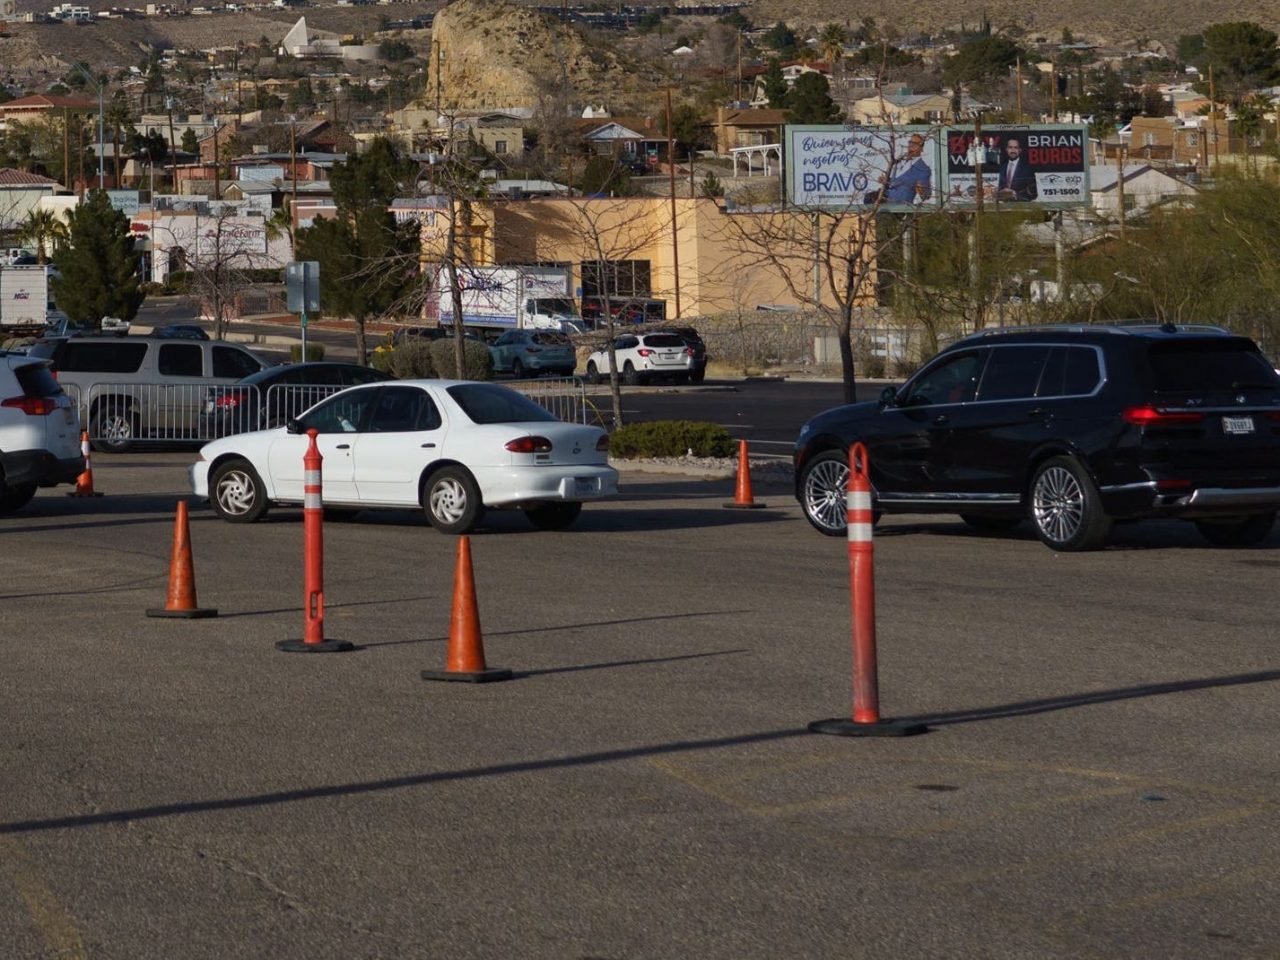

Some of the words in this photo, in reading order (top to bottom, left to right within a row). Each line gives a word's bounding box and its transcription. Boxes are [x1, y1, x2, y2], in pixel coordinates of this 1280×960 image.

[1028, 135, 1081, 147] BRIAN
[1028, 148, 1082, 164] BURDS
[803, 172, 868, 191] BRAVO
[1042, 188, 1080, 196] 751-1500
